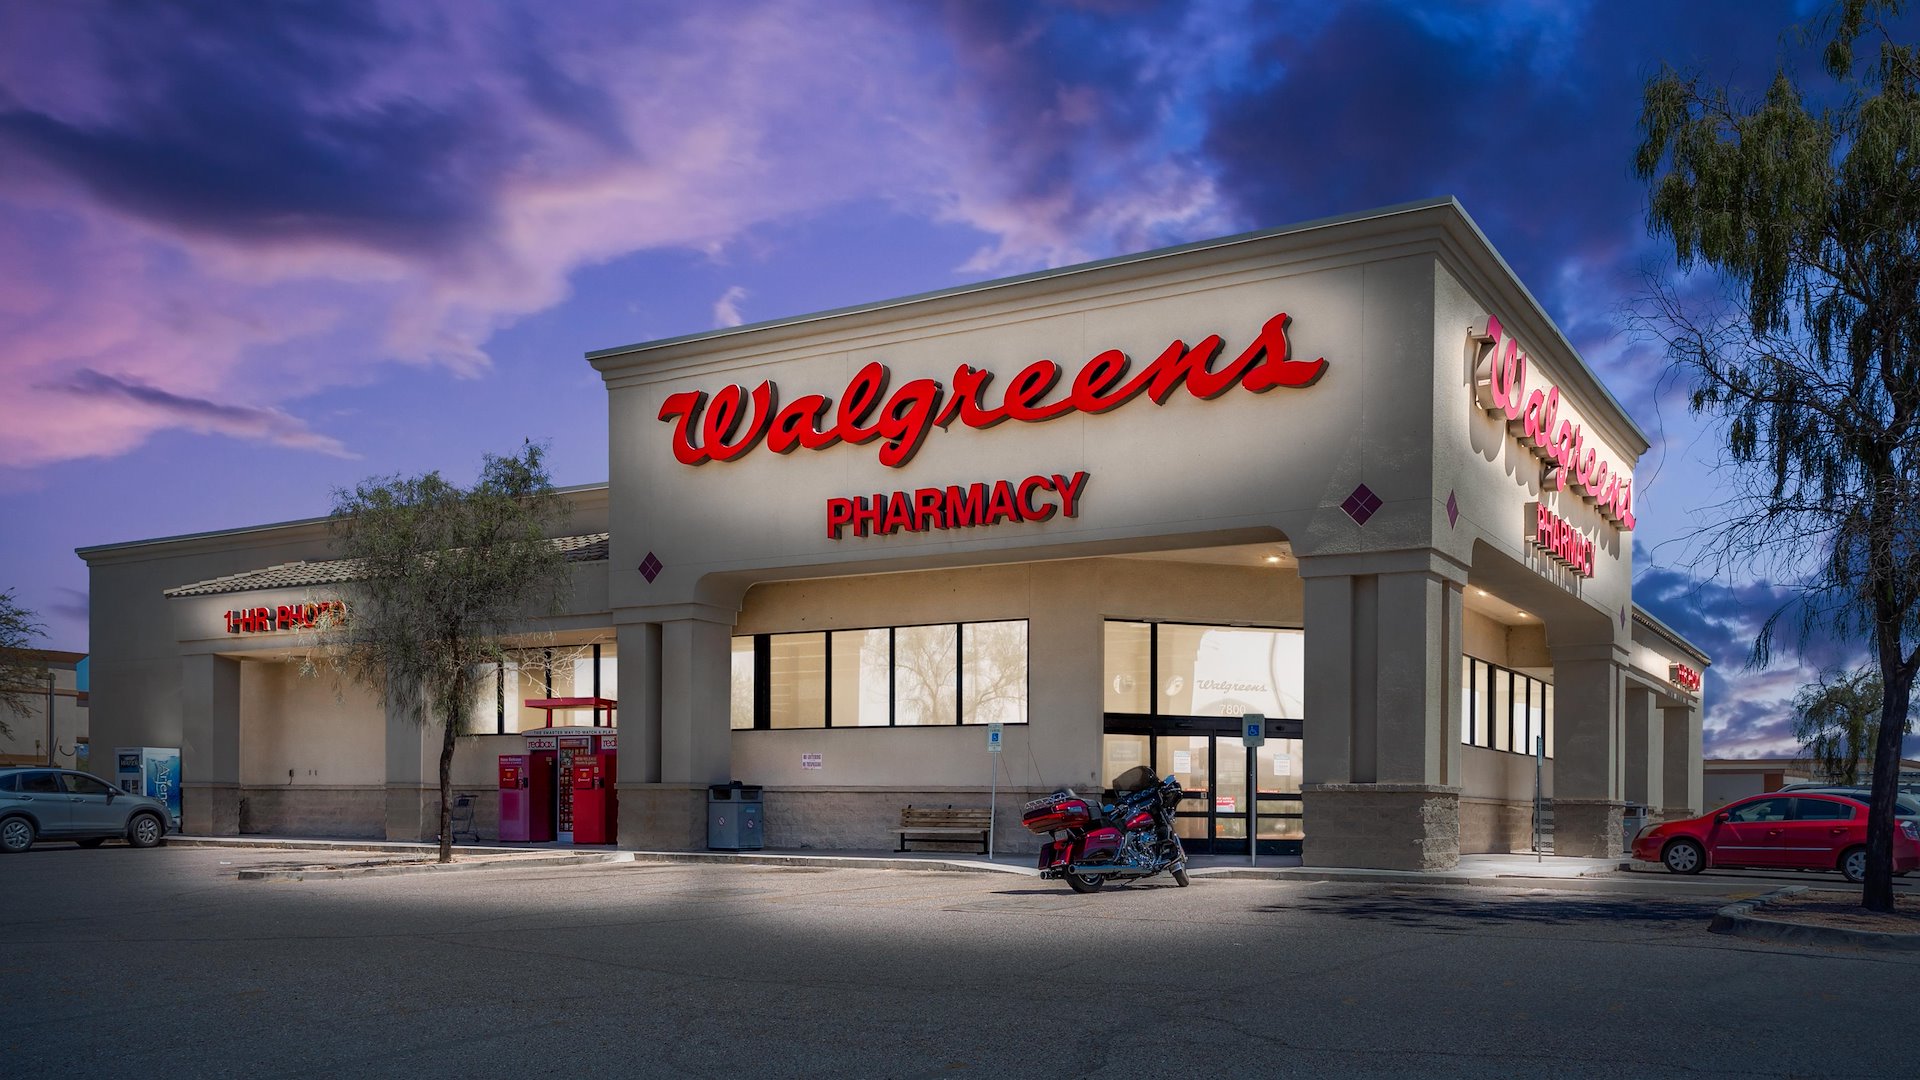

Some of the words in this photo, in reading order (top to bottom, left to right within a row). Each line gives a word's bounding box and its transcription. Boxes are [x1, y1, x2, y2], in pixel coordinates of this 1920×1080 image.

[658, 312, 1329, 467] Walgreens
[1470, 314, 1636, 531] Walgreens
[827, 471, 1089, 539] PHARMACY
[1534, 502, 1597, 578] PHARMACY
[224, 606, 270, 633] 1-HR
[1196, 679, 1268, 695] Walgreens
[1219, 704, 1246, 715] 7800
